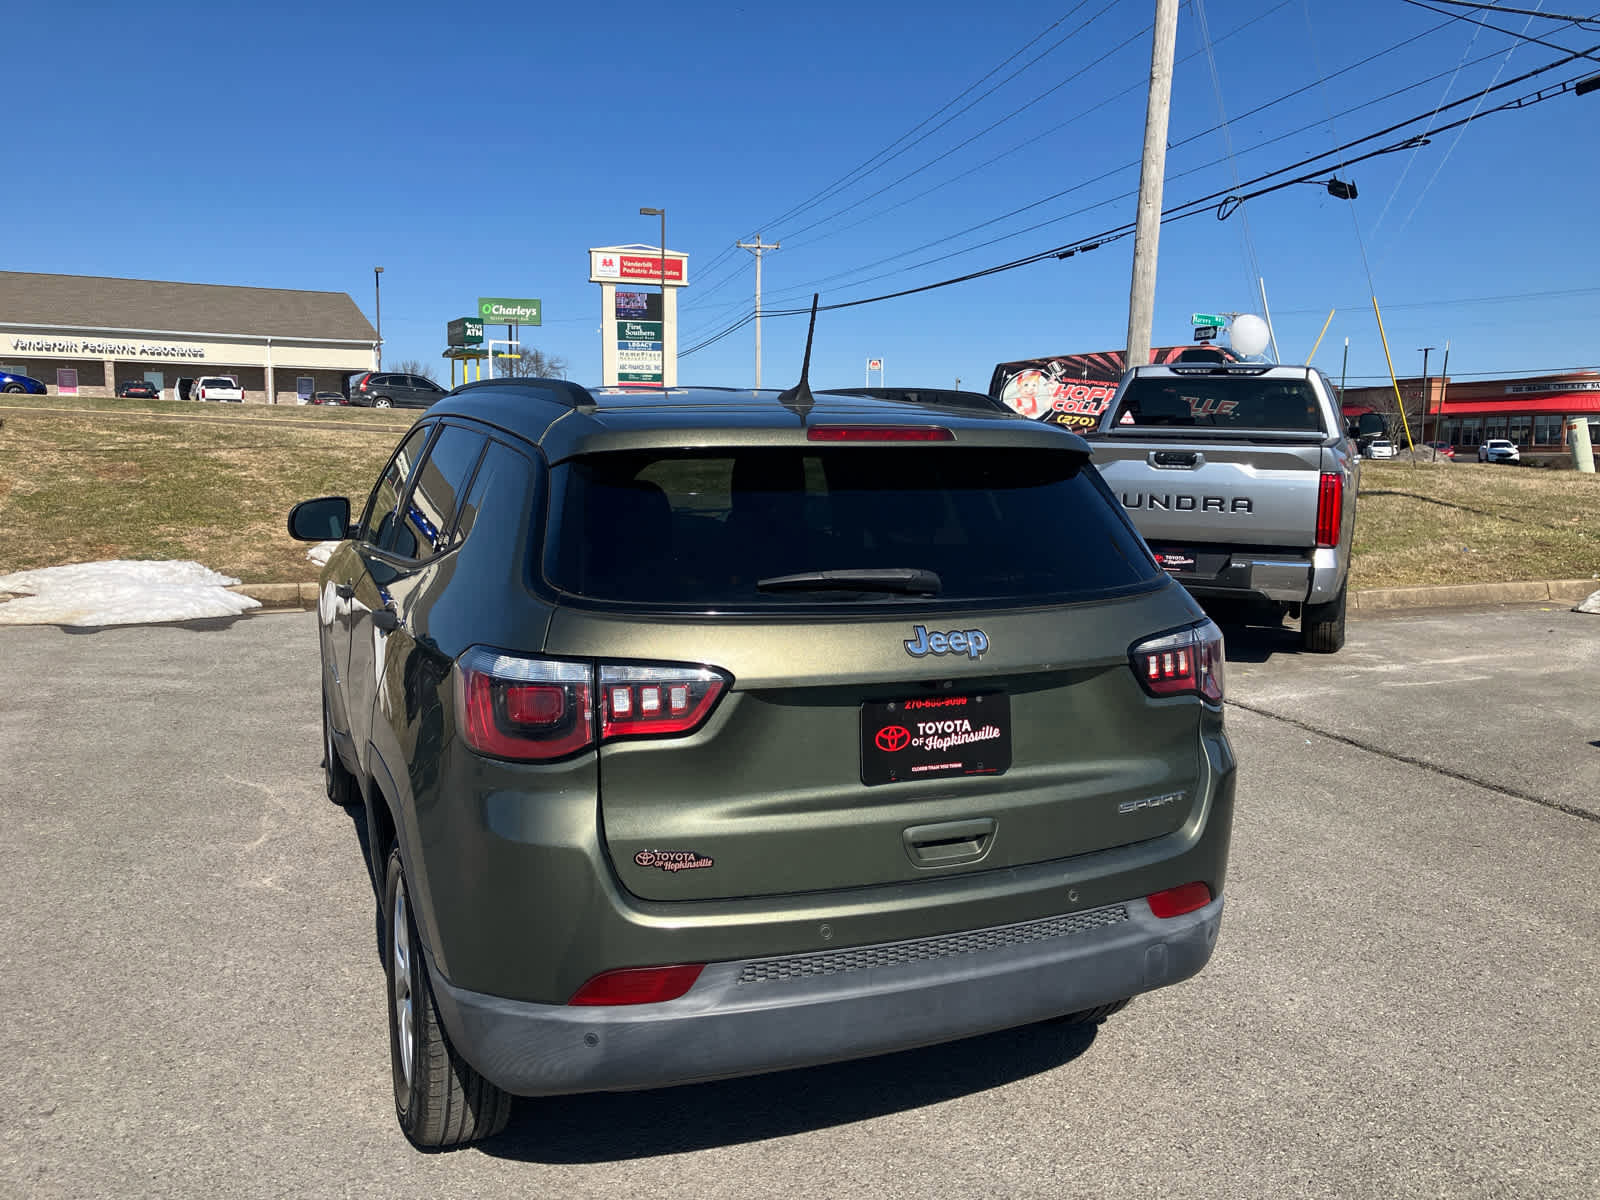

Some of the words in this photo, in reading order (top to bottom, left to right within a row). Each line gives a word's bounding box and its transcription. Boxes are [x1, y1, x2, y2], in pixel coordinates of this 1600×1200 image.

[623, 260, 653, 268] Vanderbilt
[466, 328, 483, 336] ATM
[625, 329, 655, 337] Southern
[10, 336, 79, 354] Vanderbilt
[81, 340, 137, 355] Pediatric
[139, 344, 205, 358] Associates
[1056, 414, 1096, 427] (270)
[1121, 493, 1254, 514] UNDRA
[904, 624, 990, 661] Jeep
[917, 719, 972, 736] TOYOTA
[911, 738, 924, 747] OF
[924, 725, 1001, 751] Hopkinsville
[1119, 791, 1186, 814] SPORT
[656, 852, 696, 861] TOYOTA
[664, 858, 713, 872] Hopkinsville
